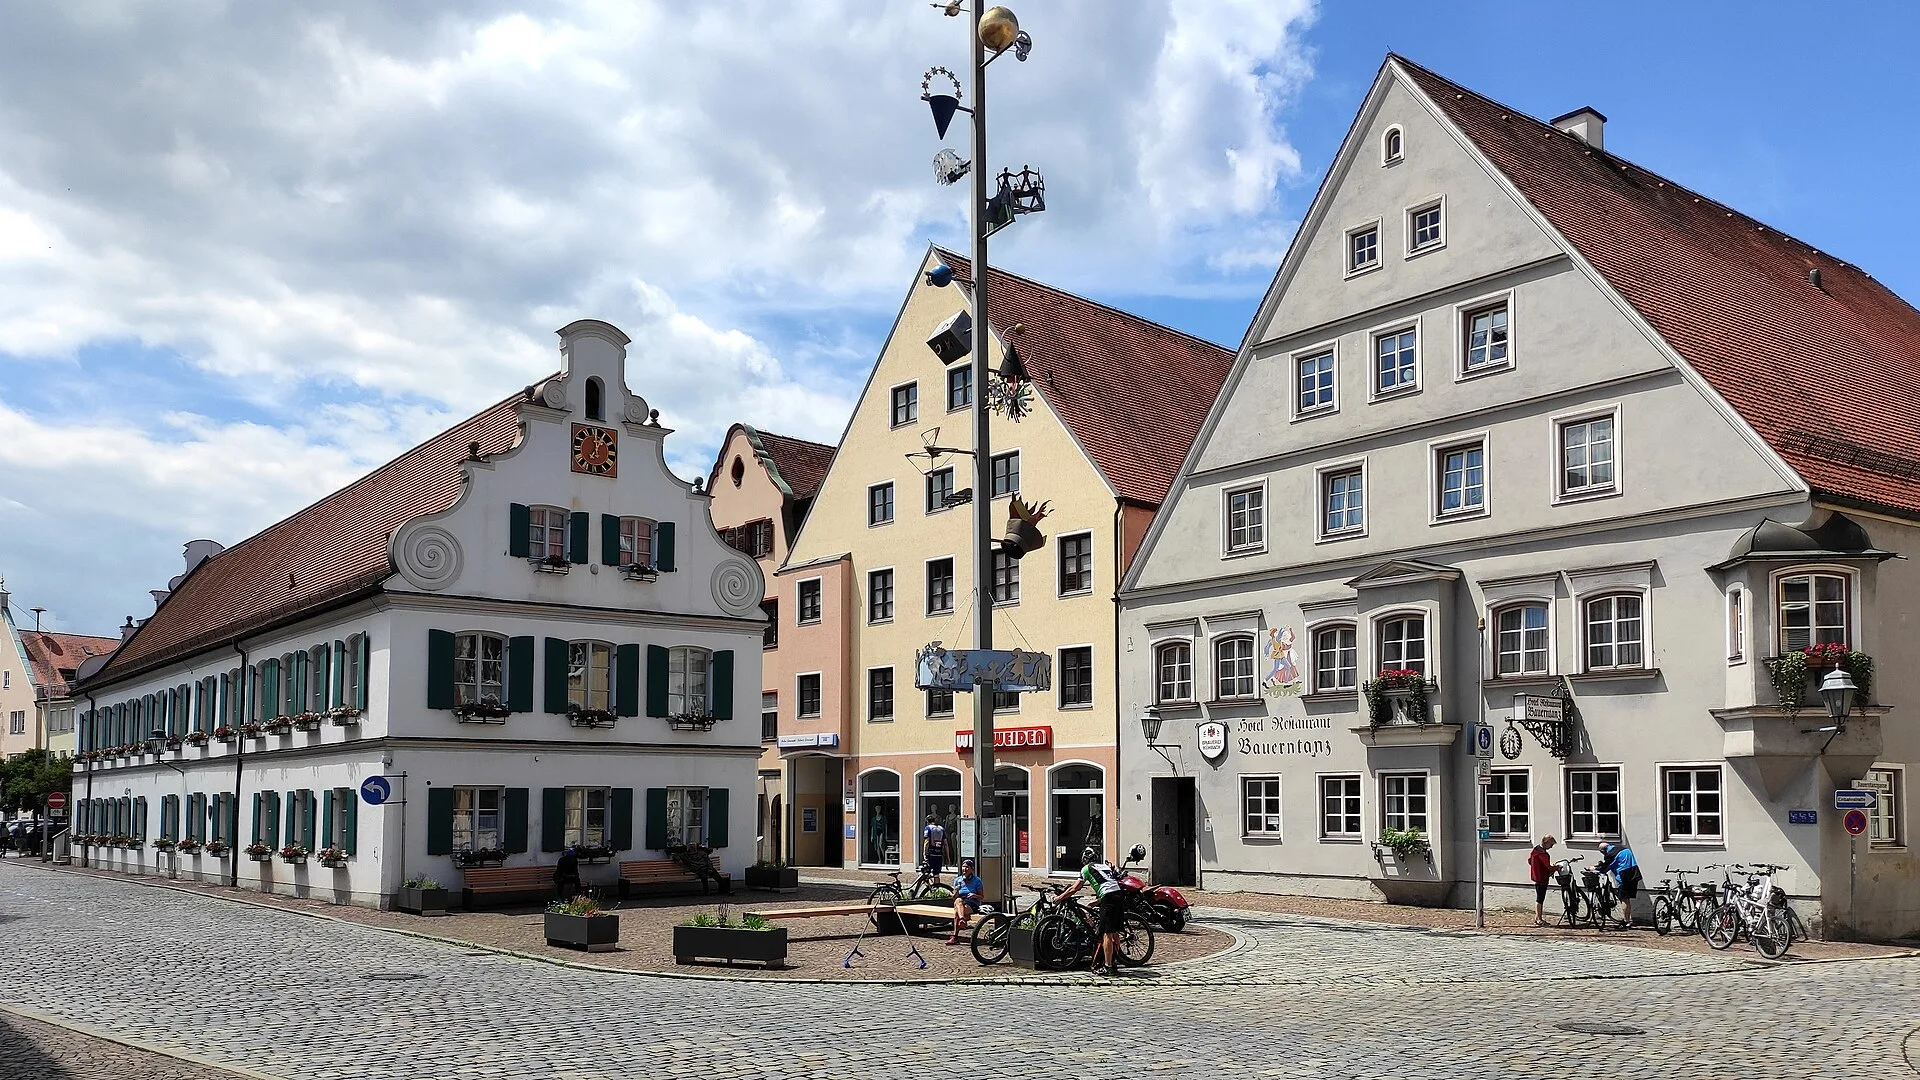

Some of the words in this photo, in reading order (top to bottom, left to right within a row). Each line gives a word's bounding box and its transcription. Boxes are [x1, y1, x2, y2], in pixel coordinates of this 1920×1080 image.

[1237, 718, 1263, 733] Hotel
[993, 729, 1046, 747] WEIDEN
[1237, 737, 1331, 757] Bauerntanz
